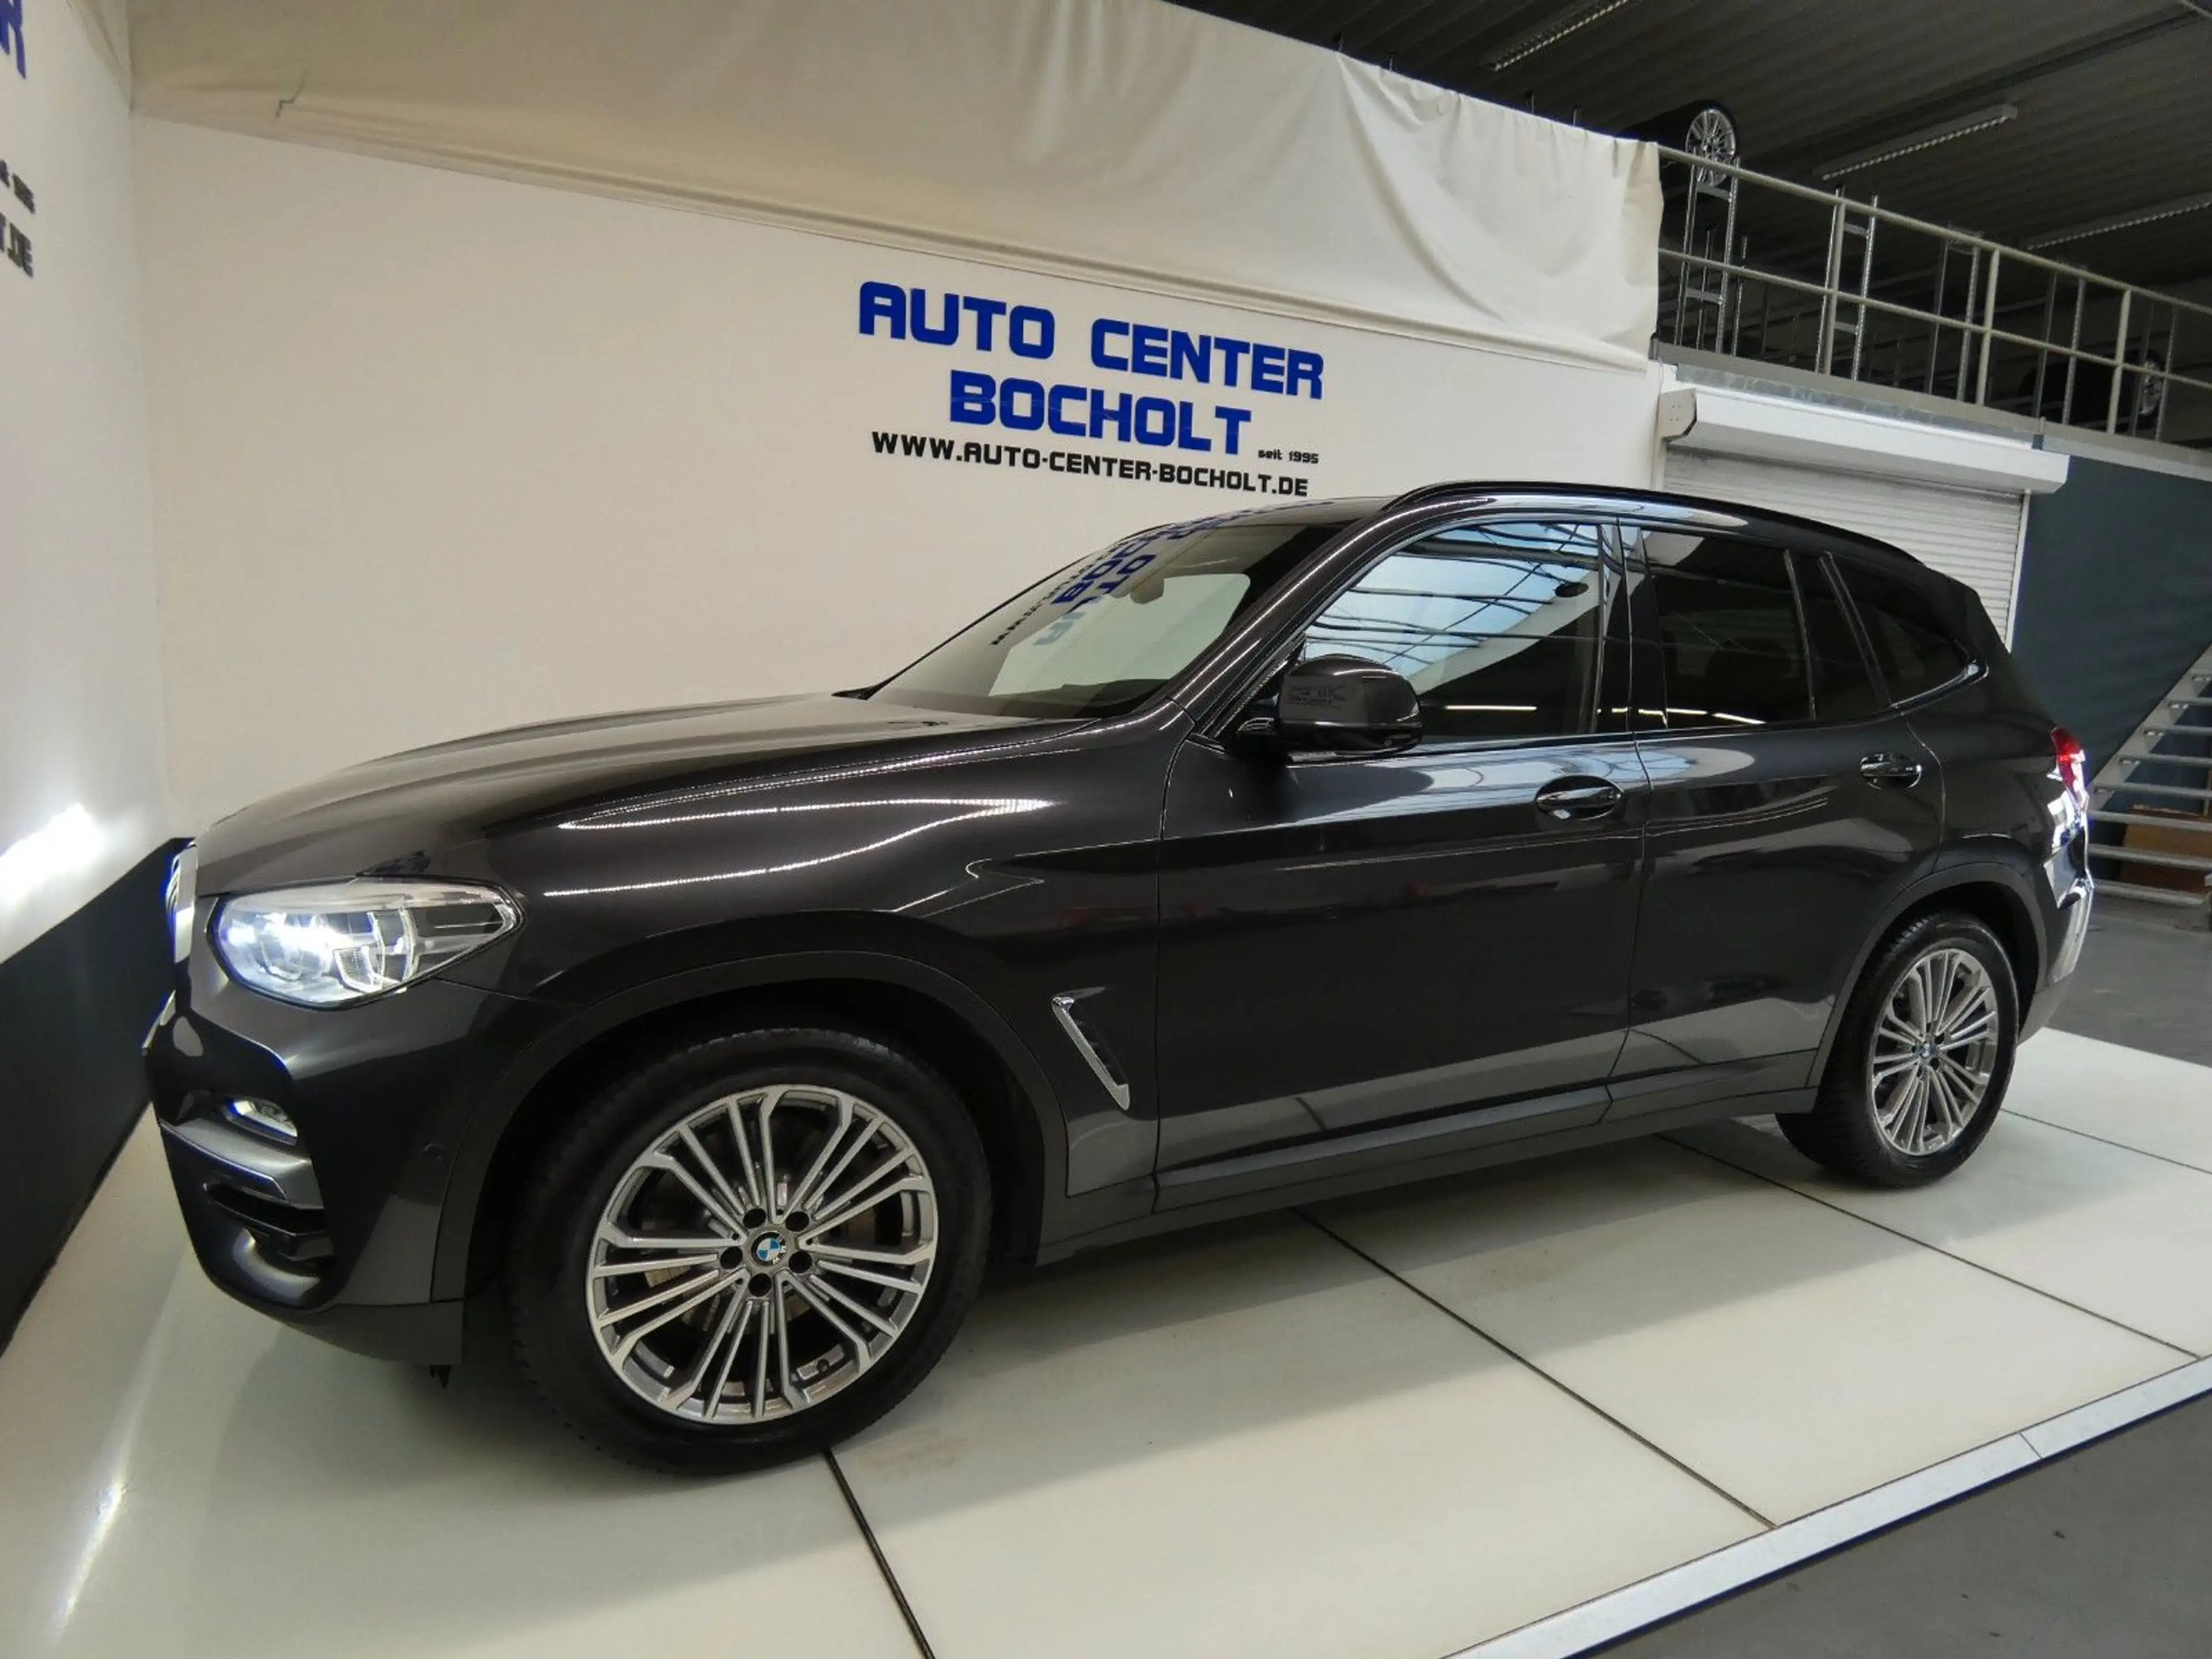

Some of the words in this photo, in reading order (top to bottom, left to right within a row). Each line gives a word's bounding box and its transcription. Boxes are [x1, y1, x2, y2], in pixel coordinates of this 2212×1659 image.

[859, 281, 1055, 359] AUTO
[1090, 318, 1324, 399] CENTER
[950, 369, 1252, 455] BOCHOLT
[871, 431, 1309, 497] WWW.AUTO-CENTER-BOCHOLT.DE
[1258, 449, 1283, 461] seit
[1289, 450, 1319, 464] 1995
